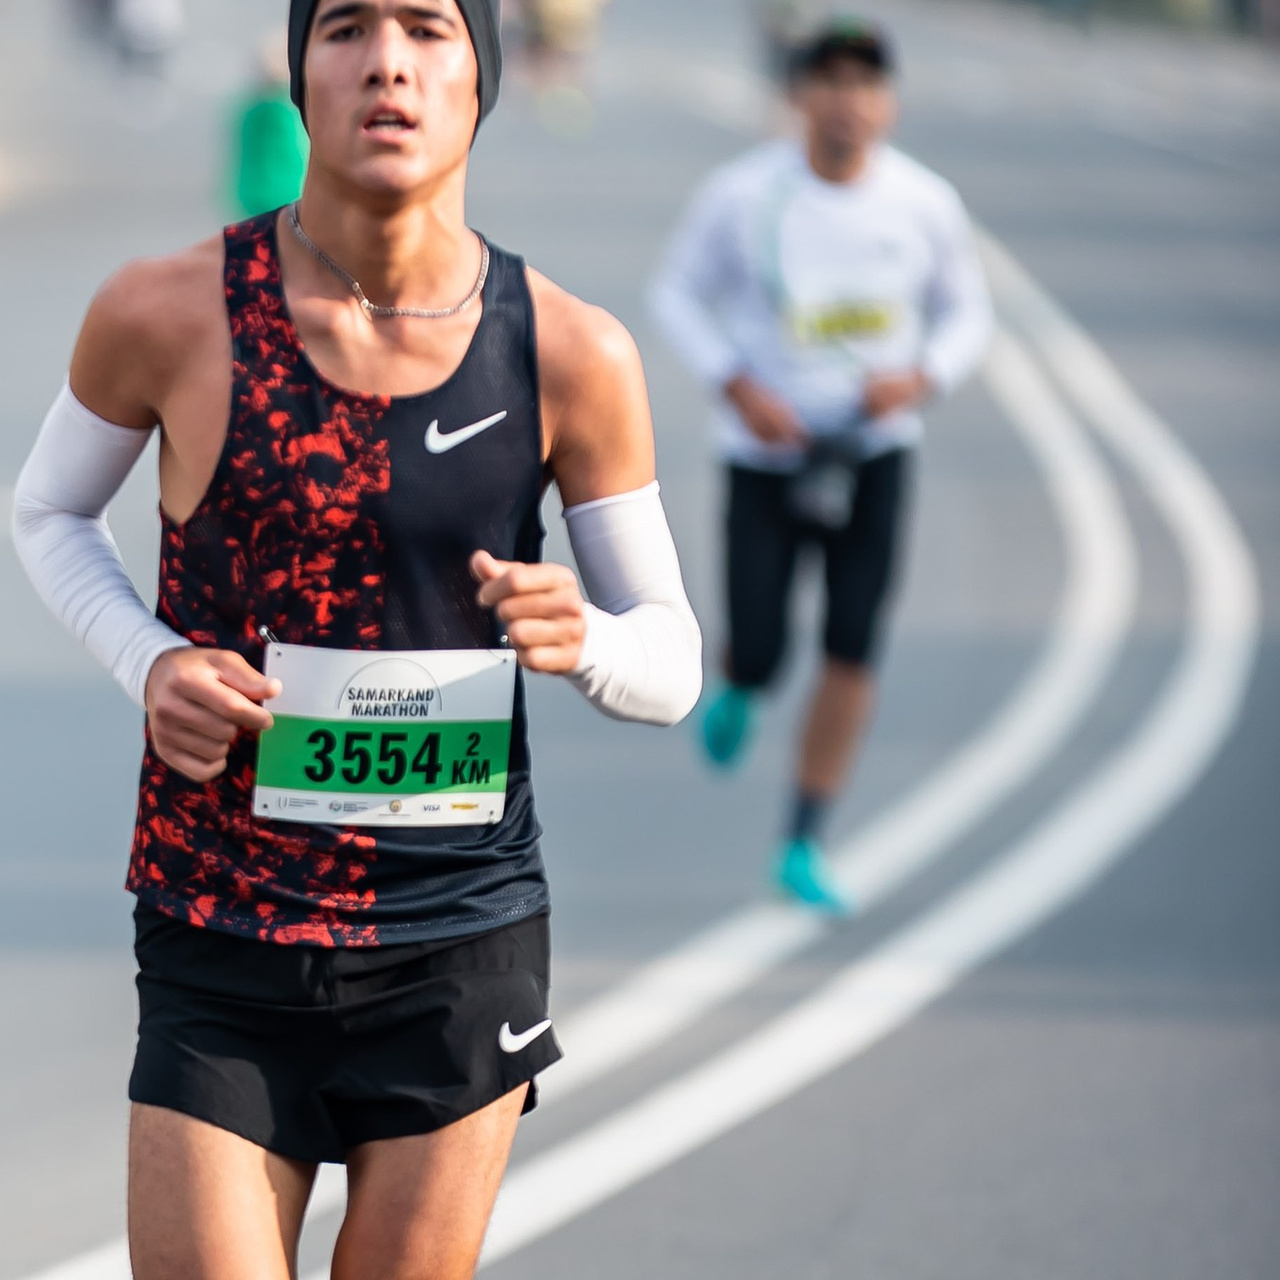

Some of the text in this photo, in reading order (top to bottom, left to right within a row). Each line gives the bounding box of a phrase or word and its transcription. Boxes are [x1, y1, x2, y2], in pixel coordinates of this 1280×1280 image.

[348, 687, 435, 702] SAMARKAND
[351, 703, 429, 717] MARATHON
[466, 732, 482, 756] 2
[304, 729, 443, 785] 3554
[451, 759, 491, 785] KM
